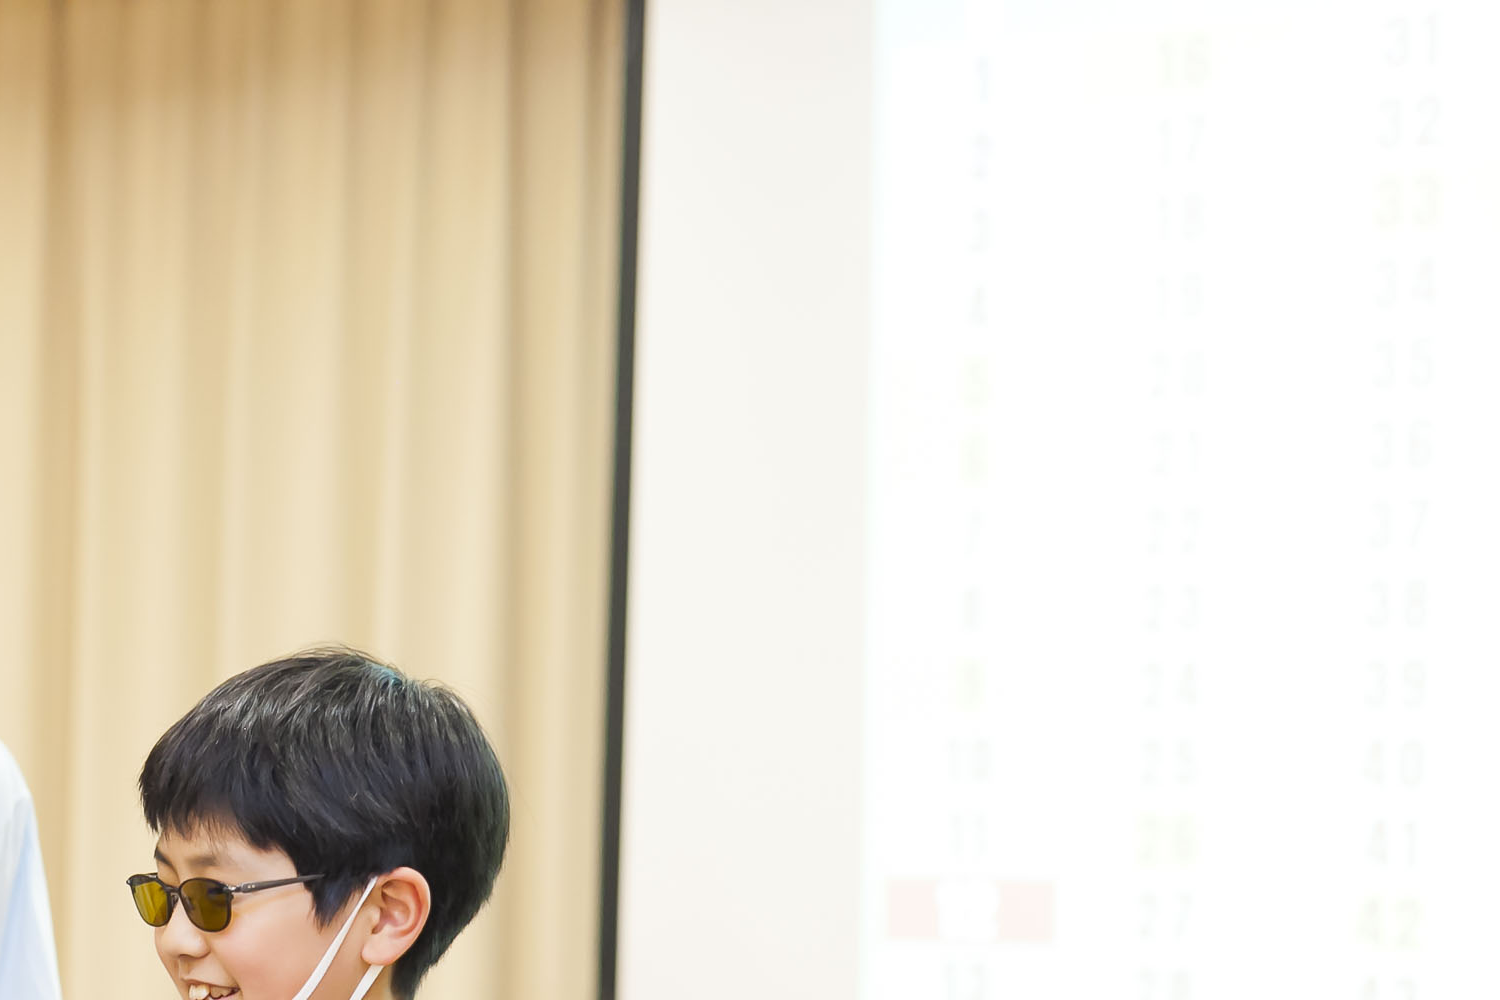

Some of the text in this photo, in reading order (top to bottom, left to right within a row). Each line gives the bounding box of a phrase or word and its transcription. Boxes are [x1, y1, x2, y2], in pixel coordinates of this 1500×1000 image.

[1382, 10, 1441, 66] 31
[1377, 92, 1442, 150] 32
[1373, 170, 1443, 232] 33
[1374, 257, 1437, 309] 34
[1372, 337, 1435, 390] 35
[1371, 417, 1434, 471] 36
[1367, 498, 1428, 551] 37
[1365, 577, 1426, 630] 38
[1364, 658, 1426, 709] 39
[1361, 738, 1425, 790] 40
[1366, 818, 1417, 870] 41
[1356, 892, 1424, 950] 42
